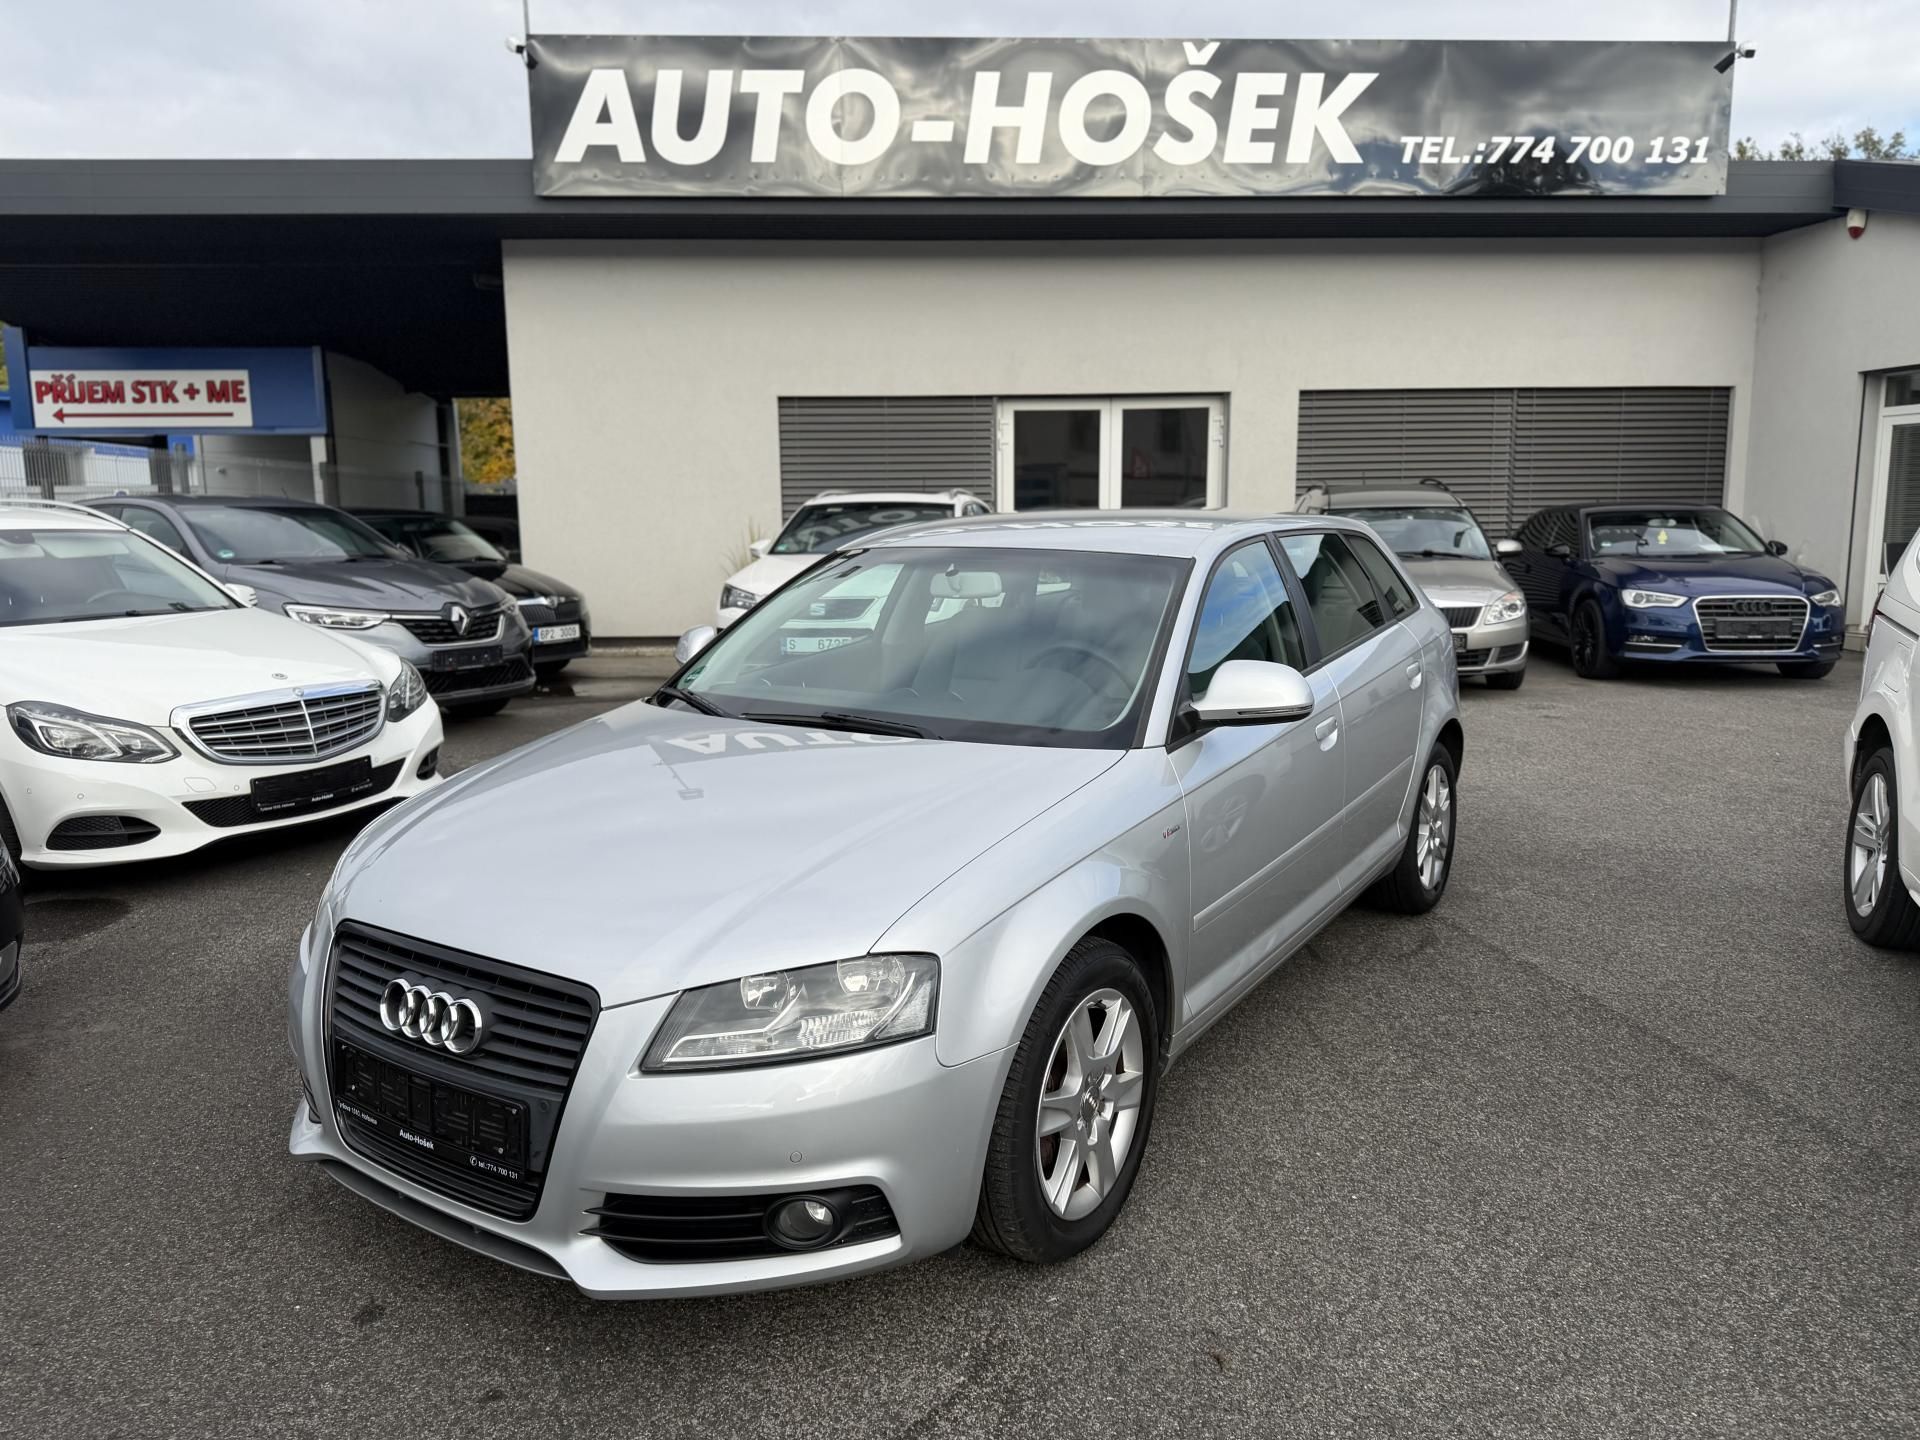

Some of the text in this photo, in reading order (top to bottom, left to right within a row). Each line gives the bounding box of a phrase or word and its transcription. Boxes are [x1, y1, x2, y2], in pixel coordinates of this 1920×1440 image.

[555, 41, 1379, 166] AUTO-HOŠEK
[1401, 136, 1710, 164] TEL.:774 700 131
[35, 373, 247, 404] PŘÍJEM STK + ME
